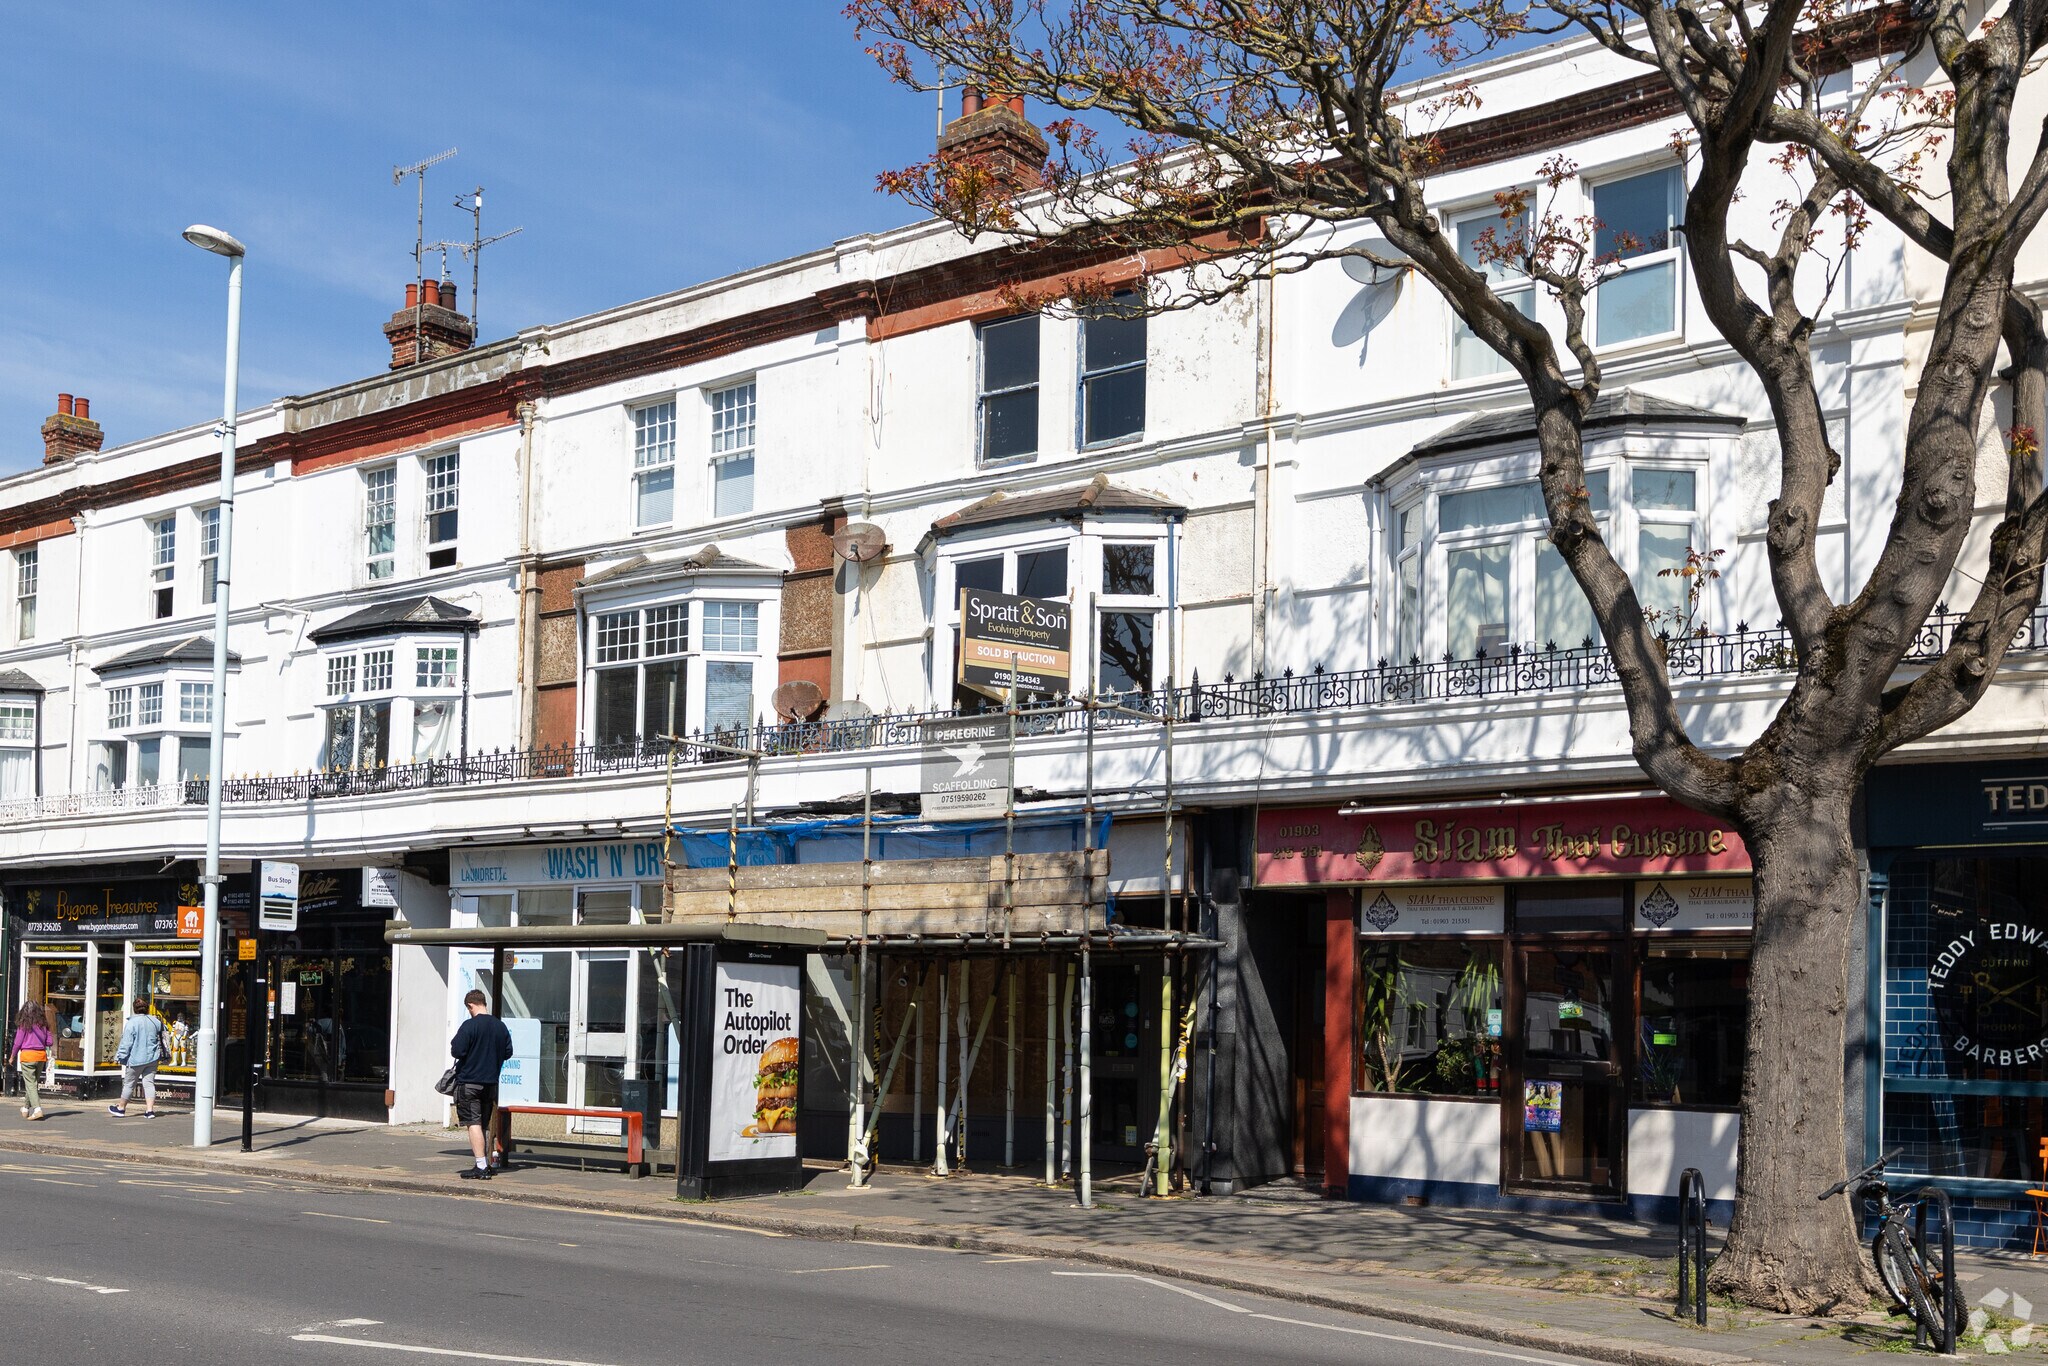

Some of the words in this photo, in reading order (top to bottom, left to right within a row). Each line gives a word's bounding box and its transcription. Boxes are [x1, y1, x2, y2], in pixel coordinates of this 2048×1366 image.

[970, 598, 1019, 624] Spratt
[1021, 606, 1034, 624] &
[1036, 608, 1066, 630] Son
[988, 622, 1020, 638] Evolving
[1020, 626, 1050, 642] Property
[977, 646, 1001, 657] SOLD
[1004, 650, 1014, 659] BY
[1016, 652, 1056, 664] AUCTION
[990, 680, 1045, 691] WWW.SPRAANDSON.CO.UK
[994, 672, 1016, 682] 0190
[1016, 675, 1040, 685] 234343
[937, 726, 995, 740] PEREGRINE
[932, 778, 997, 792] SCAFFOLDING
[941, 792, 986, 803] 07519590262
[1280, 824, 1319, 838] 01903
[1413, 820, 1517, 864] Siam
[1532, 822, 1600, 860] Thai
[1611, 824, 1728, 862] Cuisine
[1273, 848, 1294, 860] 215
[1301, 846, 1323, 858] 351
[548, 846, 599, 879] WASH
[604, 844, 627, 877] 'N'
[1689, 887, 1722, 897] SIAM
[1725, 889, 1749, 897] THAI
[57, 890, 99, 921] Bygone
[102, 888, 159, 921] Treasures
[1407, 895, 1435, 904] SIAM
[77, 922, 138, 932] www.bygonetreasures.com
[154, 920, 173, 929] 07376
[1927, 930, 1975, 990] TEDDY
[725, 988, 753, 1008] The
[724, 1010, 791, 1036] Autopilot
[724, 1034, 767, 1054] Order
[501, 1074, 522, 1085] SERVICE
